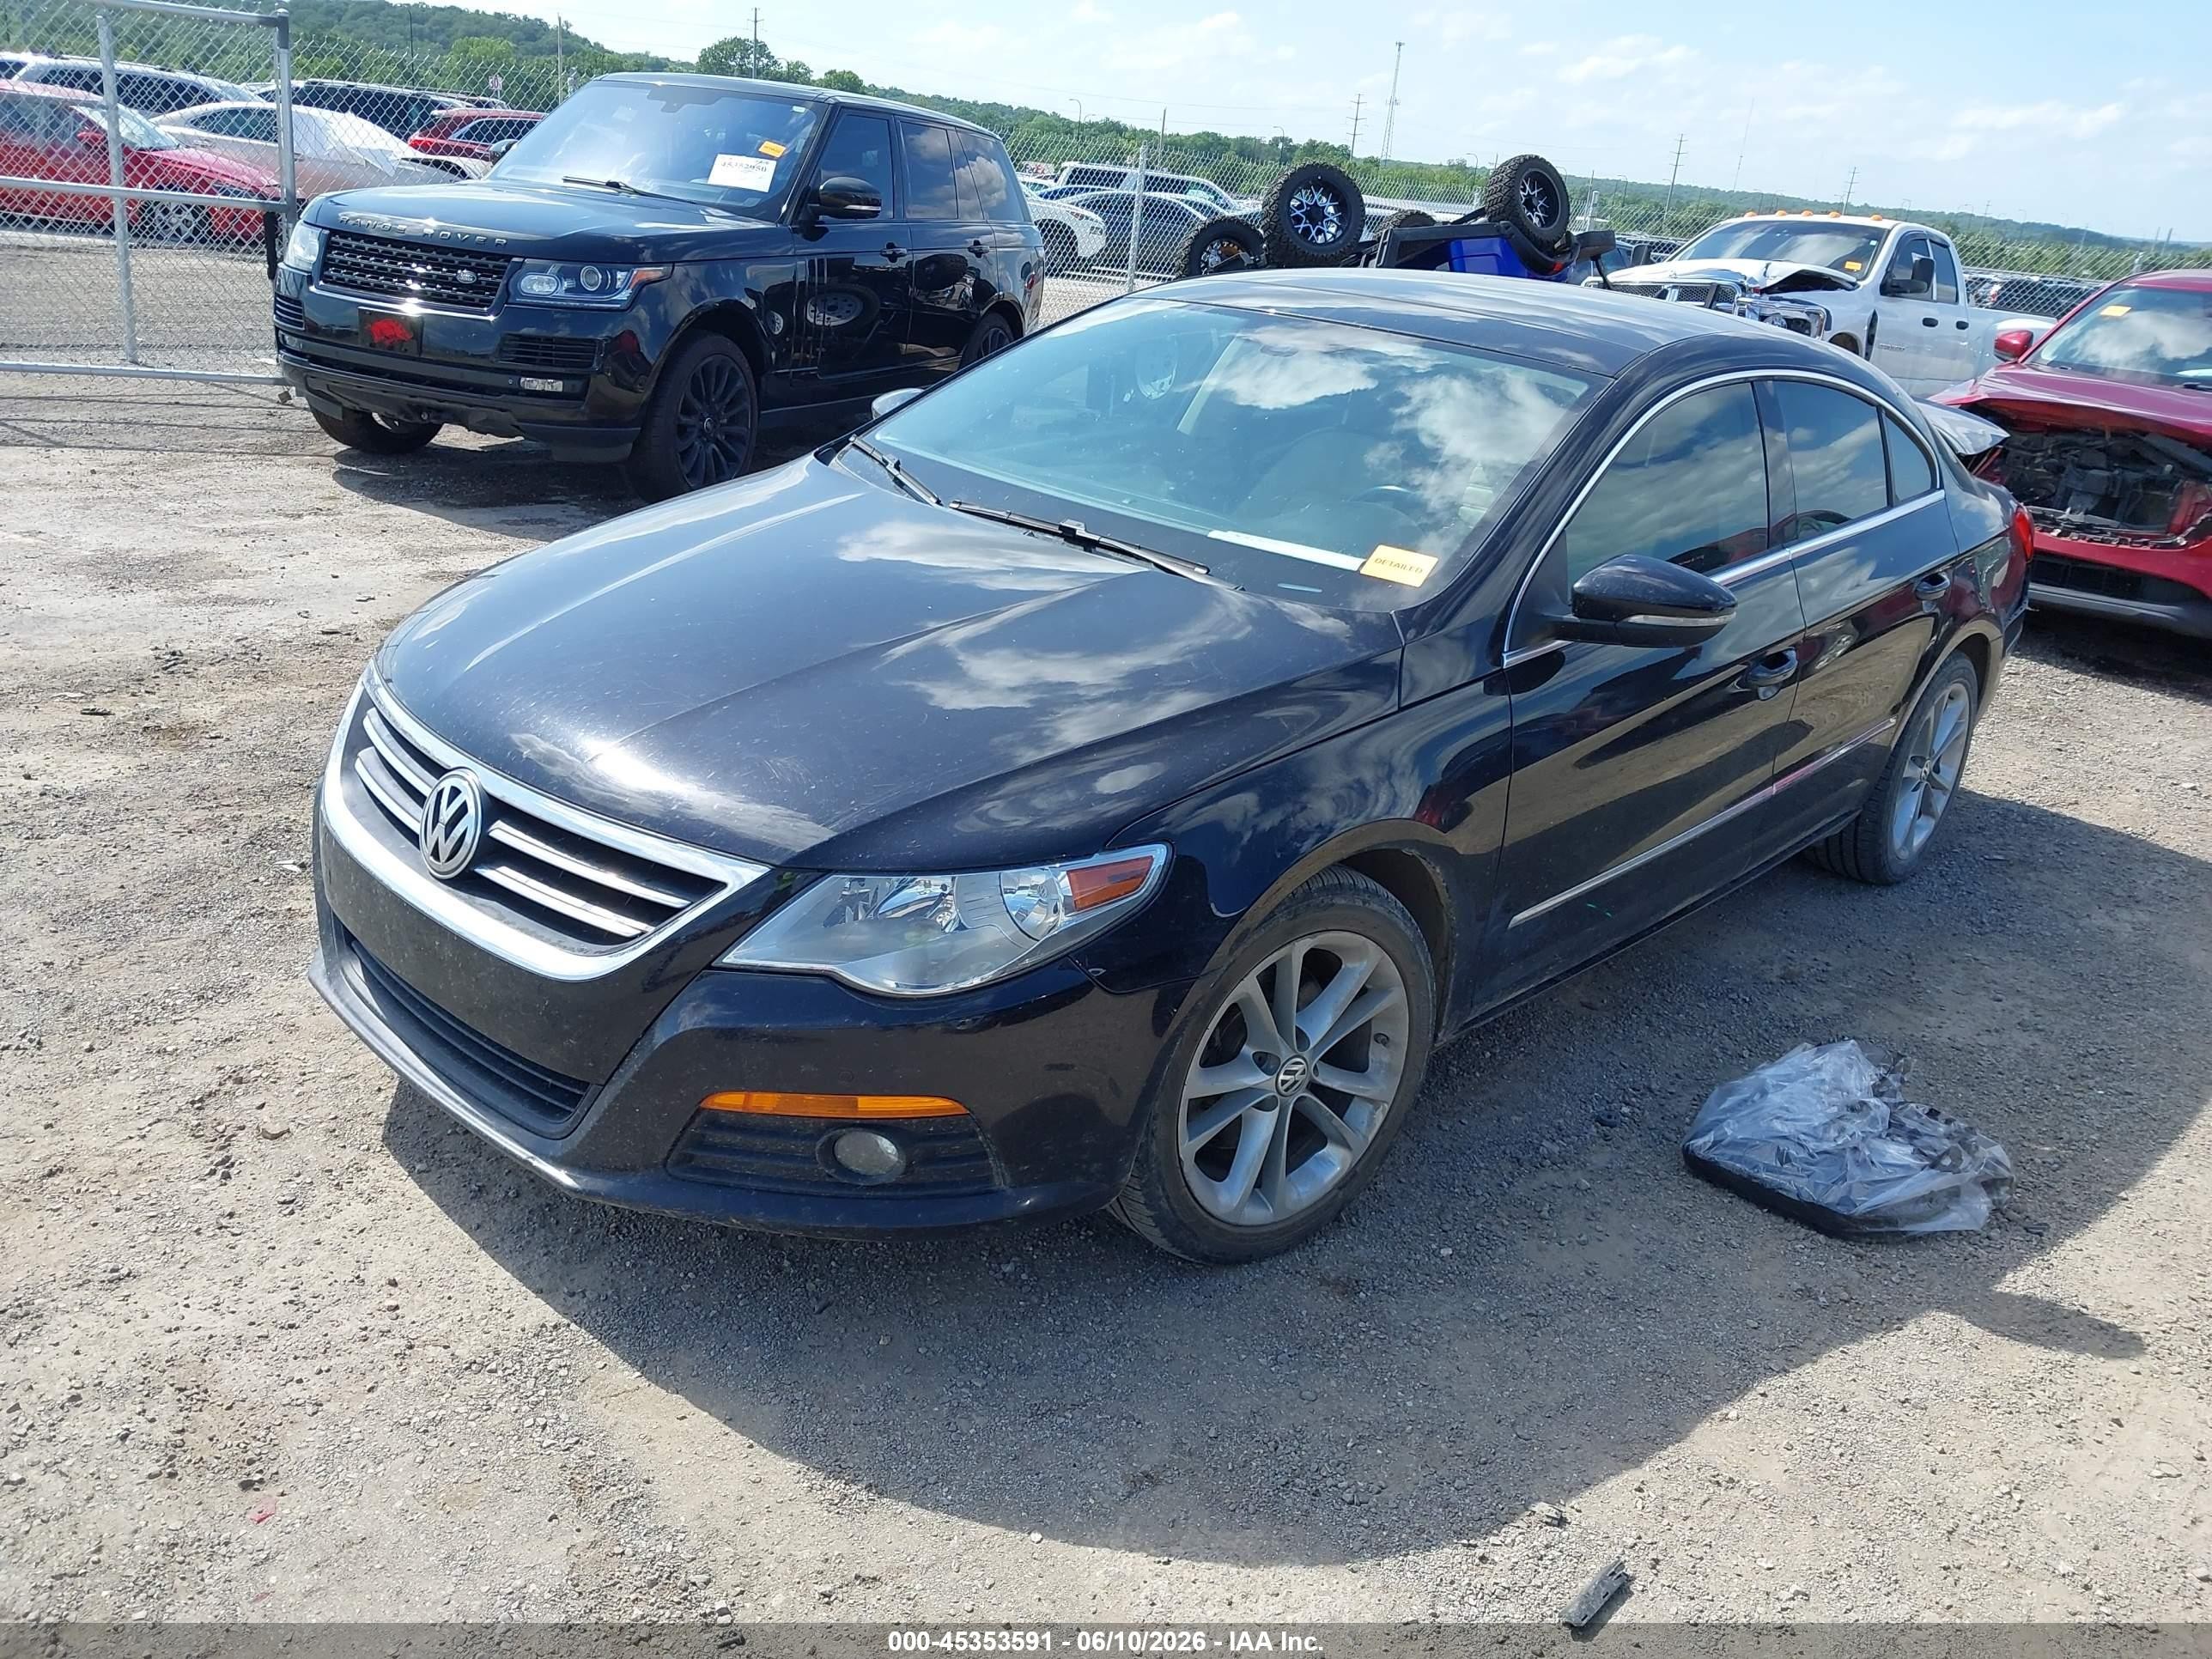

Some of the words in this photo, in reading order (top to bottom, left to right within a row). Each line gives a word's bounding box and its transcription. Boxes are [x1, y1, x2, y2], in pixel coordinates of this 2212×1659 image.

[338, 216, 407, 234] RANGE
[422, 228, 508, 247] ROVER
[1374, 557, 1423, 574] DETAILED
